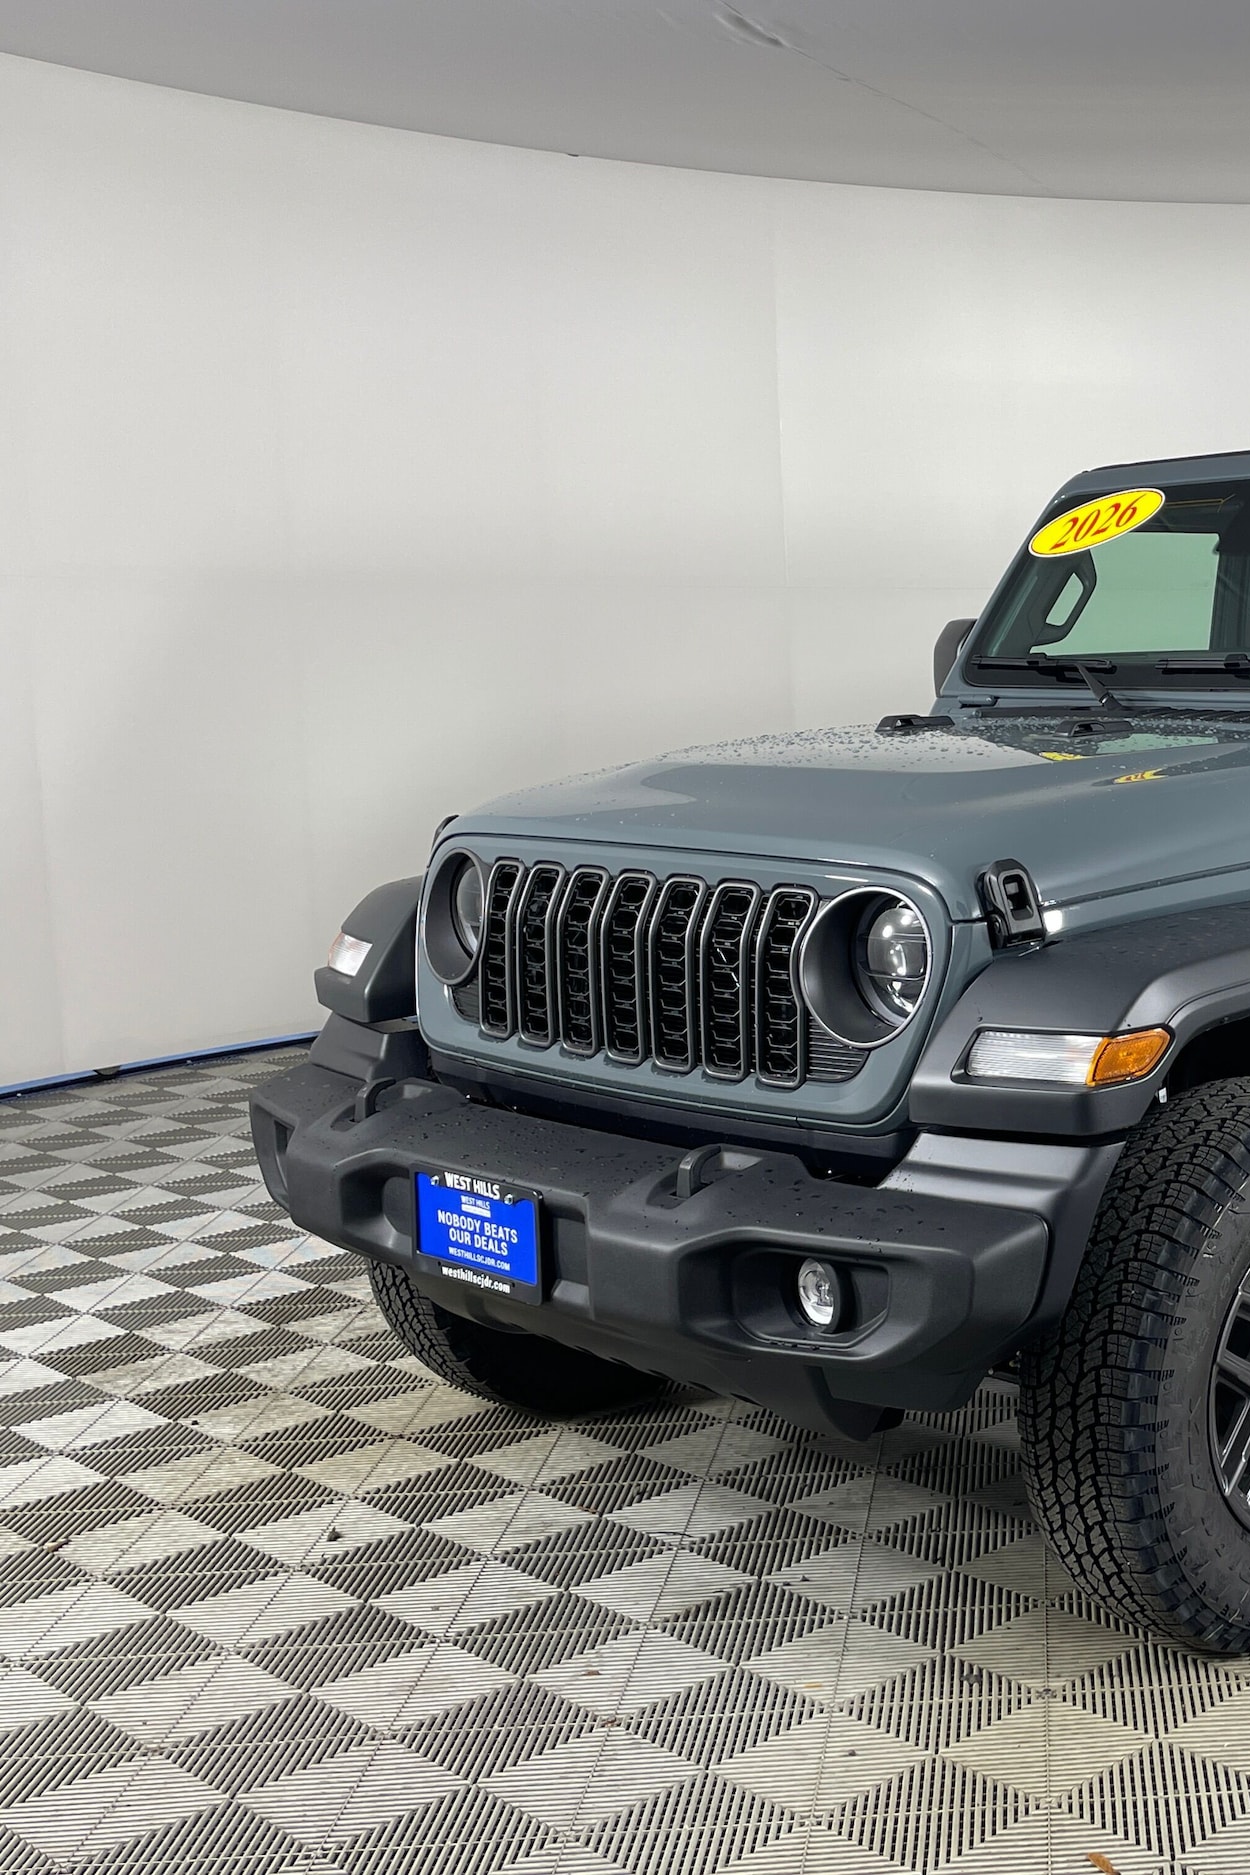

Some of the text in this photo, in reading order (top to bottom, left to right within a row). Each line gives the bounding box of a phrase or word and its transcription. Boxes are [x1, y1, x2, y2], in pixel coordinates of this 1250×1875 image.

[1049, 493, 1147, 551] 2026
[444, 1171, 501, 1200] WEST HILLS
[460, 1195, 491, 1210] WEST HILLS
[437, 1209, 481, 1233] NOBODY
[484, 1222, 518, 1243] BEATS
[449, 1228, 508, 1256] OUR DEALS
[448, 1246, 511, 1271] WESTHILLSCJDR.COM
[441, 1266, 511, 1294] westhillscjdr.com
